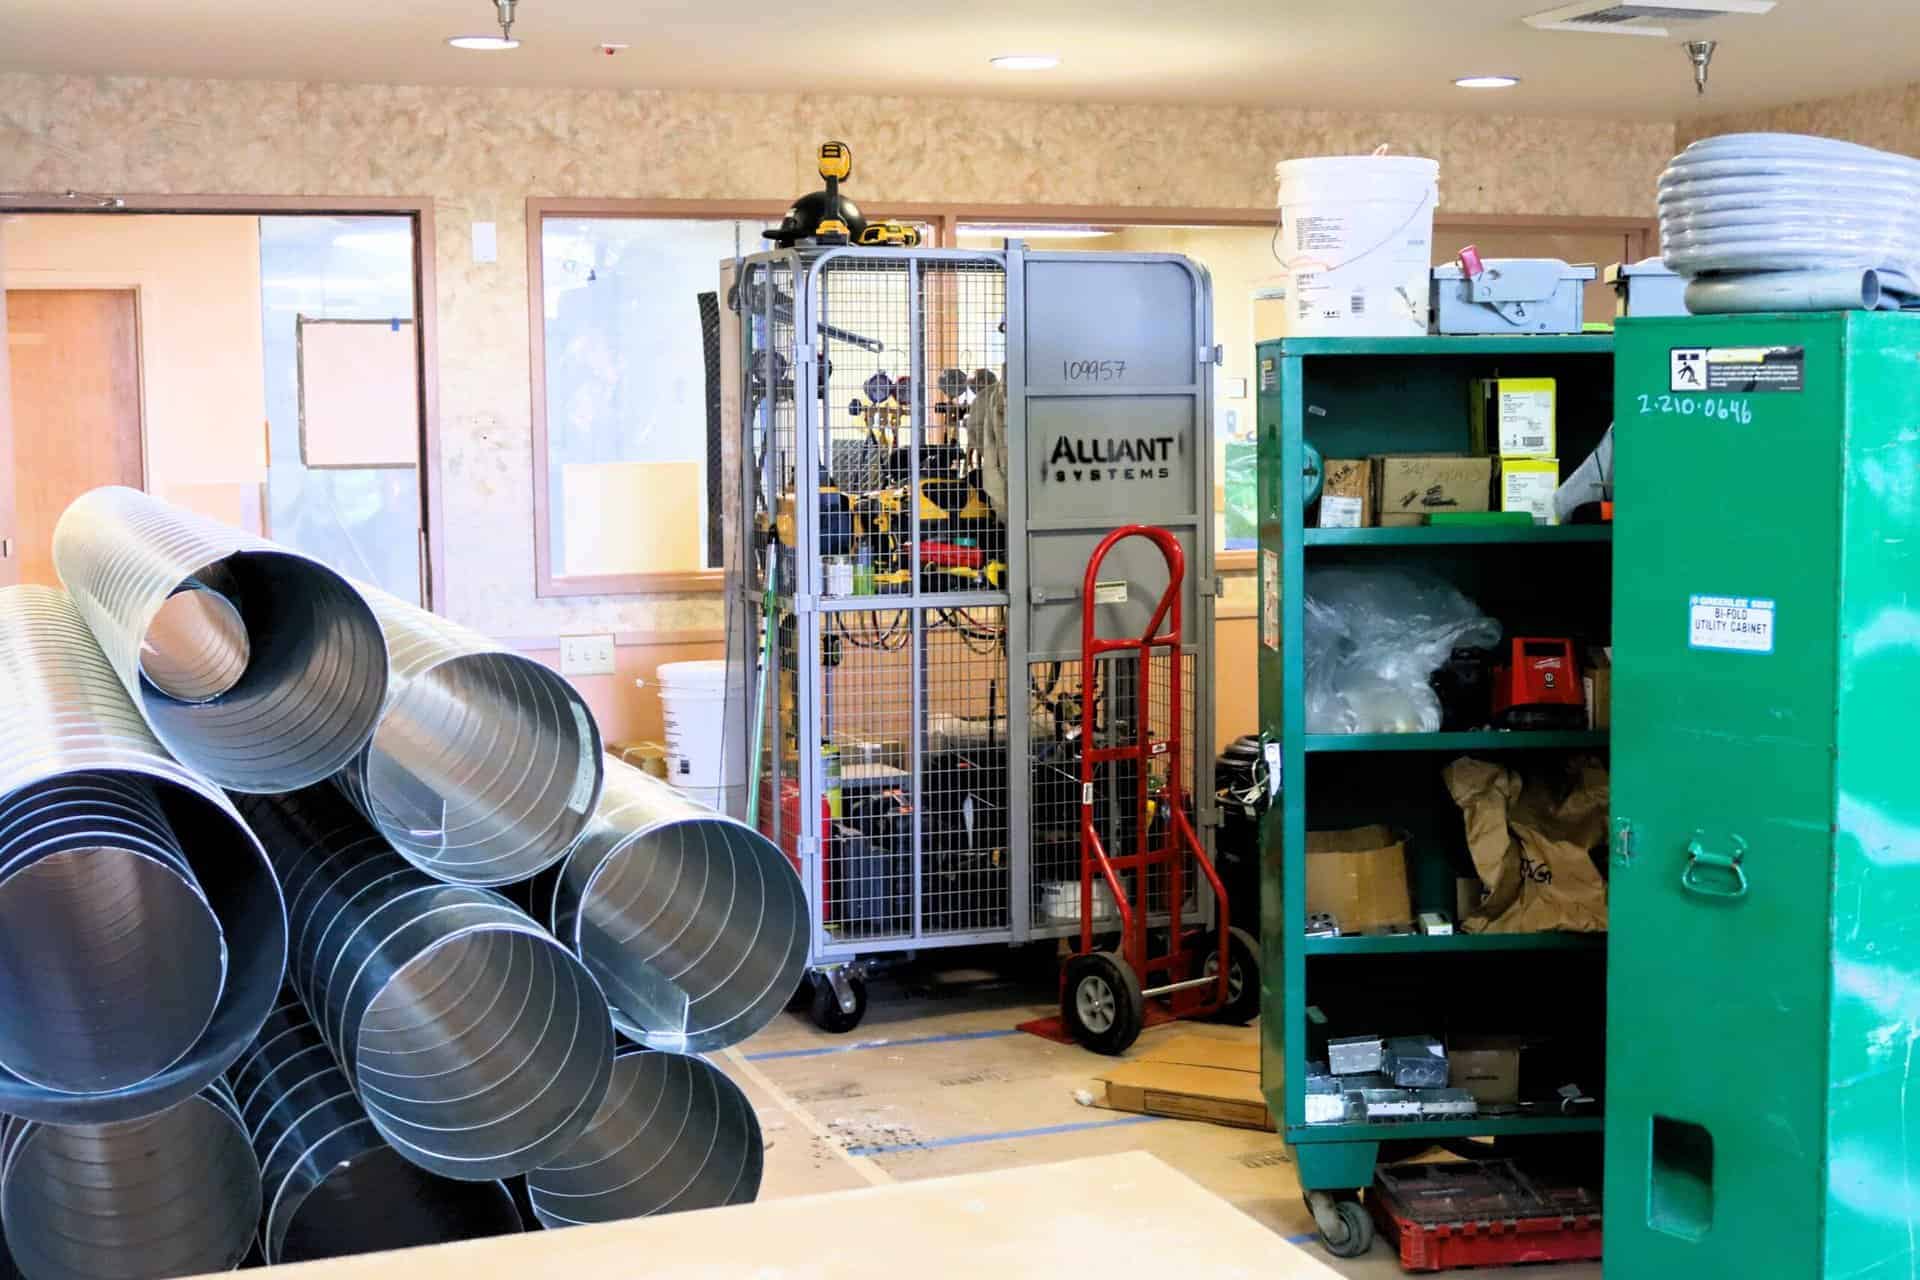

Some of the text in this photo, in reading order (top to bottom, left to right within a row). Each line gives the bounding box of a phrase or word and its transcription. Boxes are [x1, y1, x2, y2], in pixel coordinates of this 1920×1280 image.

[1063, 359, 1126, 381] 109957
[1051, 435, 1174, 464] ALLIANT
[1055, 467, 1170, 483] SYSTEMS
[1715, 608, 1747, 620] BI-FOLD
[1695, 619, 1767, 634] UTILITY CABINET
